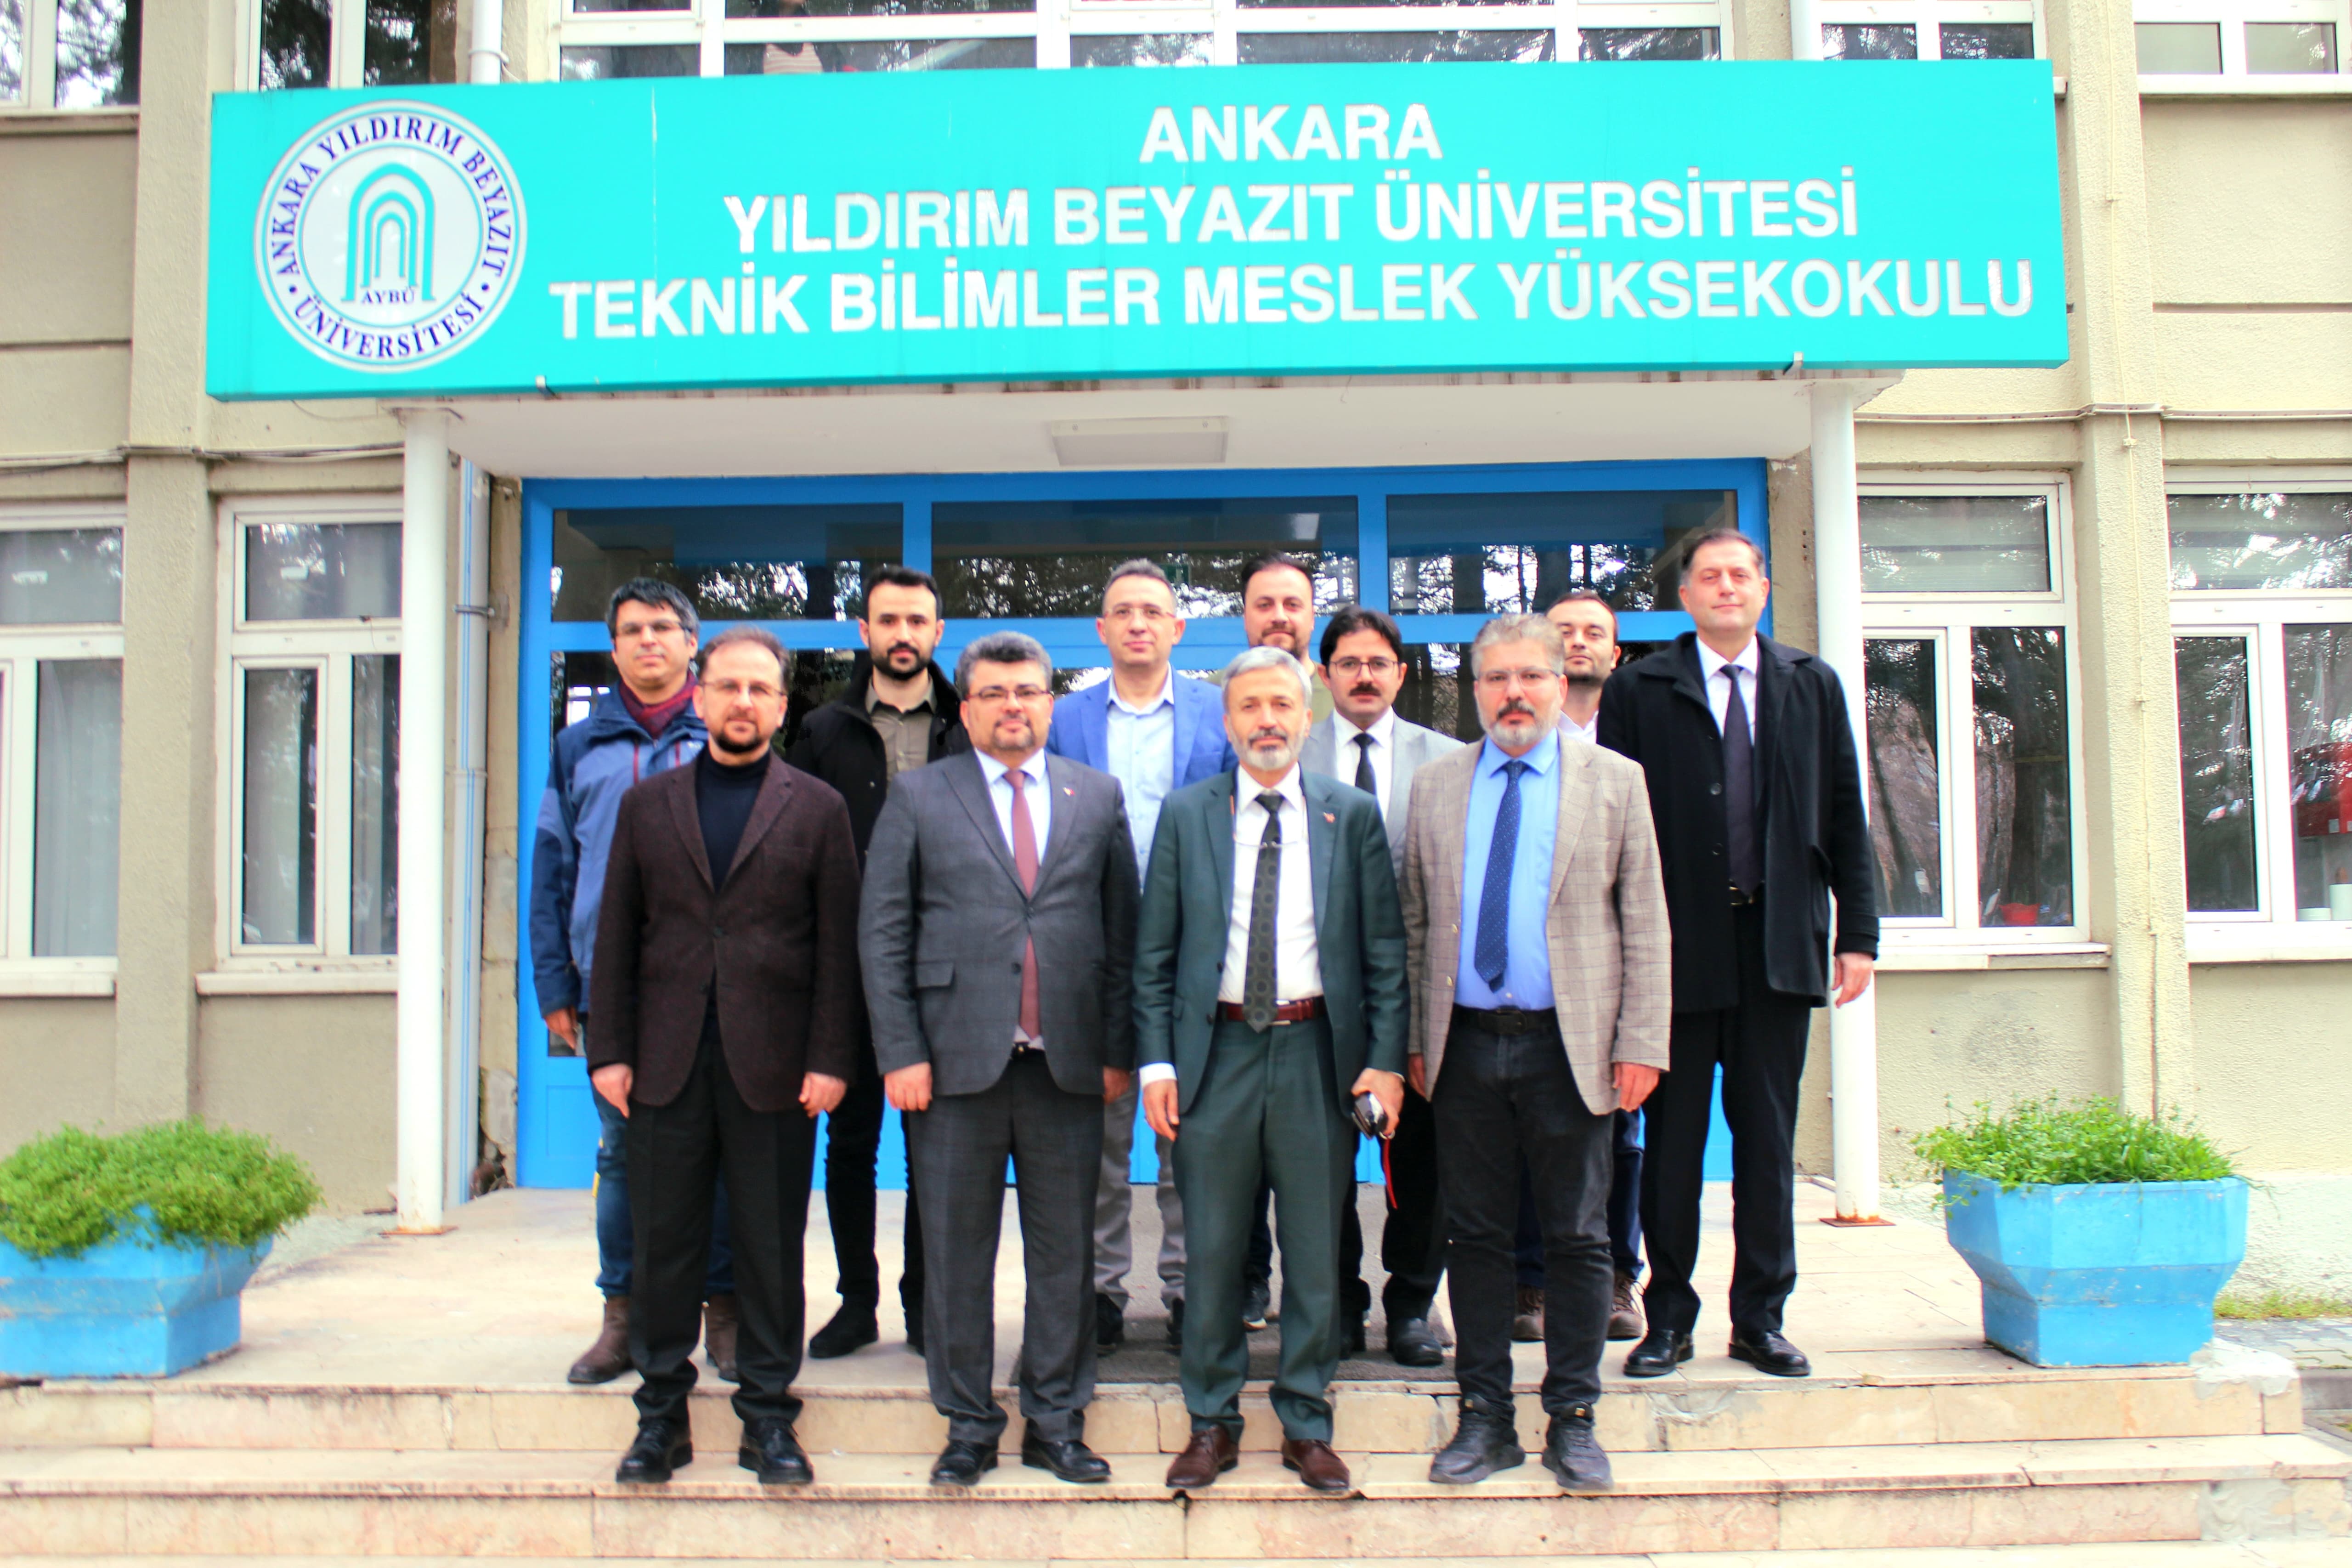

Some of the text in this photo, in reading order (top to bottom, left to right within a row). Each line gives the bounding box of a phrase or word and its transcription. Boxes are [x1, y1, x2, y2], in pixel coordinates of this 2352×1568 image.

[1140, 103, 1442, 162] ANKARA
[271, 116, 512, 277] ANKARA YILDIRIM BEYAZIT
[724, 166, 1857, 253] YILDIRIM BEYAZIT ÜNİVERSİTESİ
[294, 291, 485, 358] ÜNİVERSİTESİ
[361, 286, 415, 305] AYBÜ
[549, 248, 2032, 338] TEKNİK BİLİMLER MESLEK YÜKSEKOKULU
